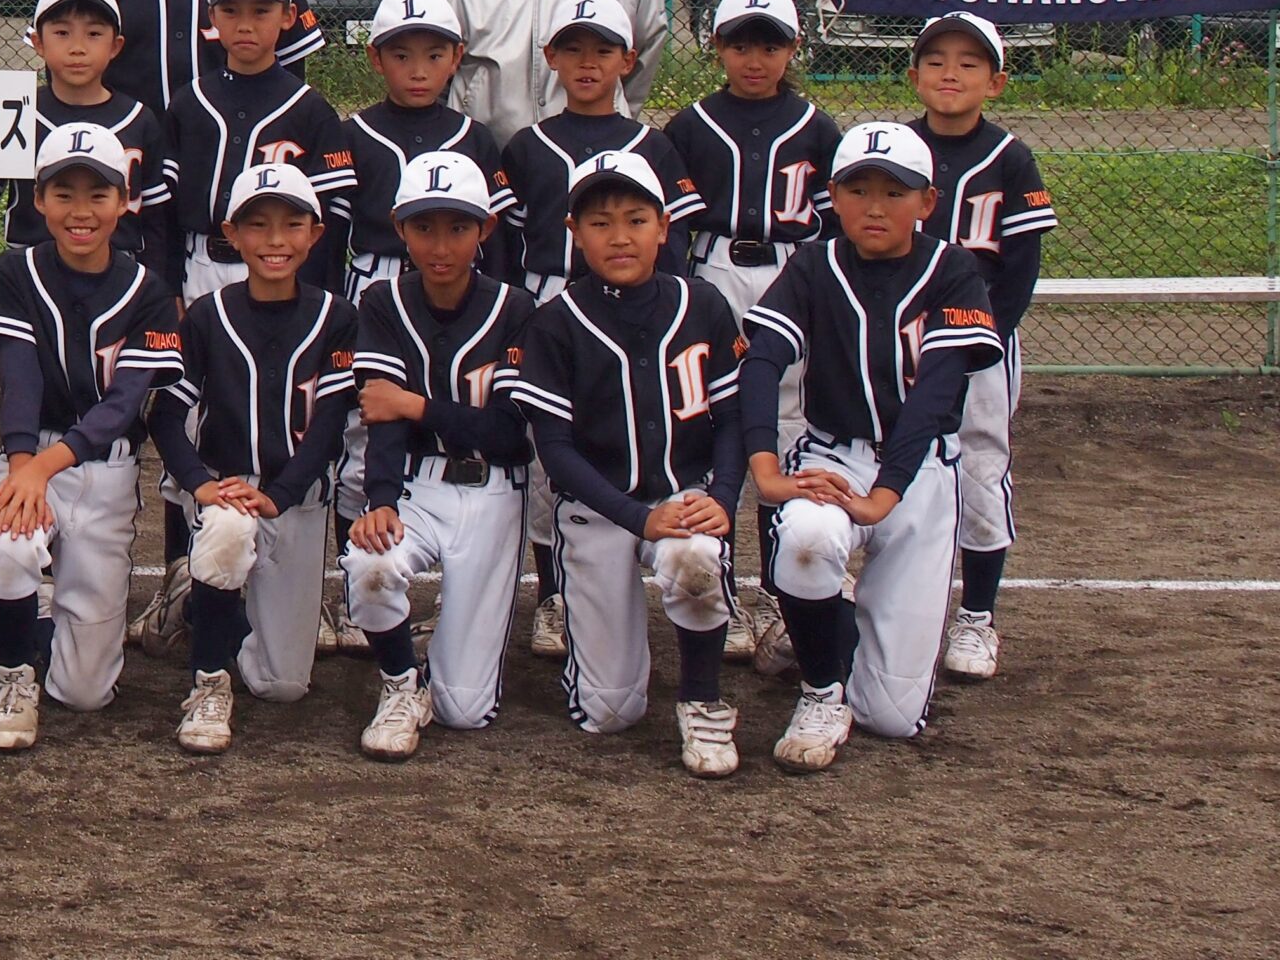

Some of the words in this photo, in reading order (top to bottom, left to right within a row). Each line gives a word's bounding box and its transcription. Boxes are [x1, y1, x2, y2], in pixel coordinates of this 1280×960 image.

[571, 0, 596, 20] L
[68, 130, 94, 153] L
[863, 130, 891, 154] L
[255, 169, 280, 192] L
[425, 165, 452, 193] L
[775, 161, 816, 225] L
